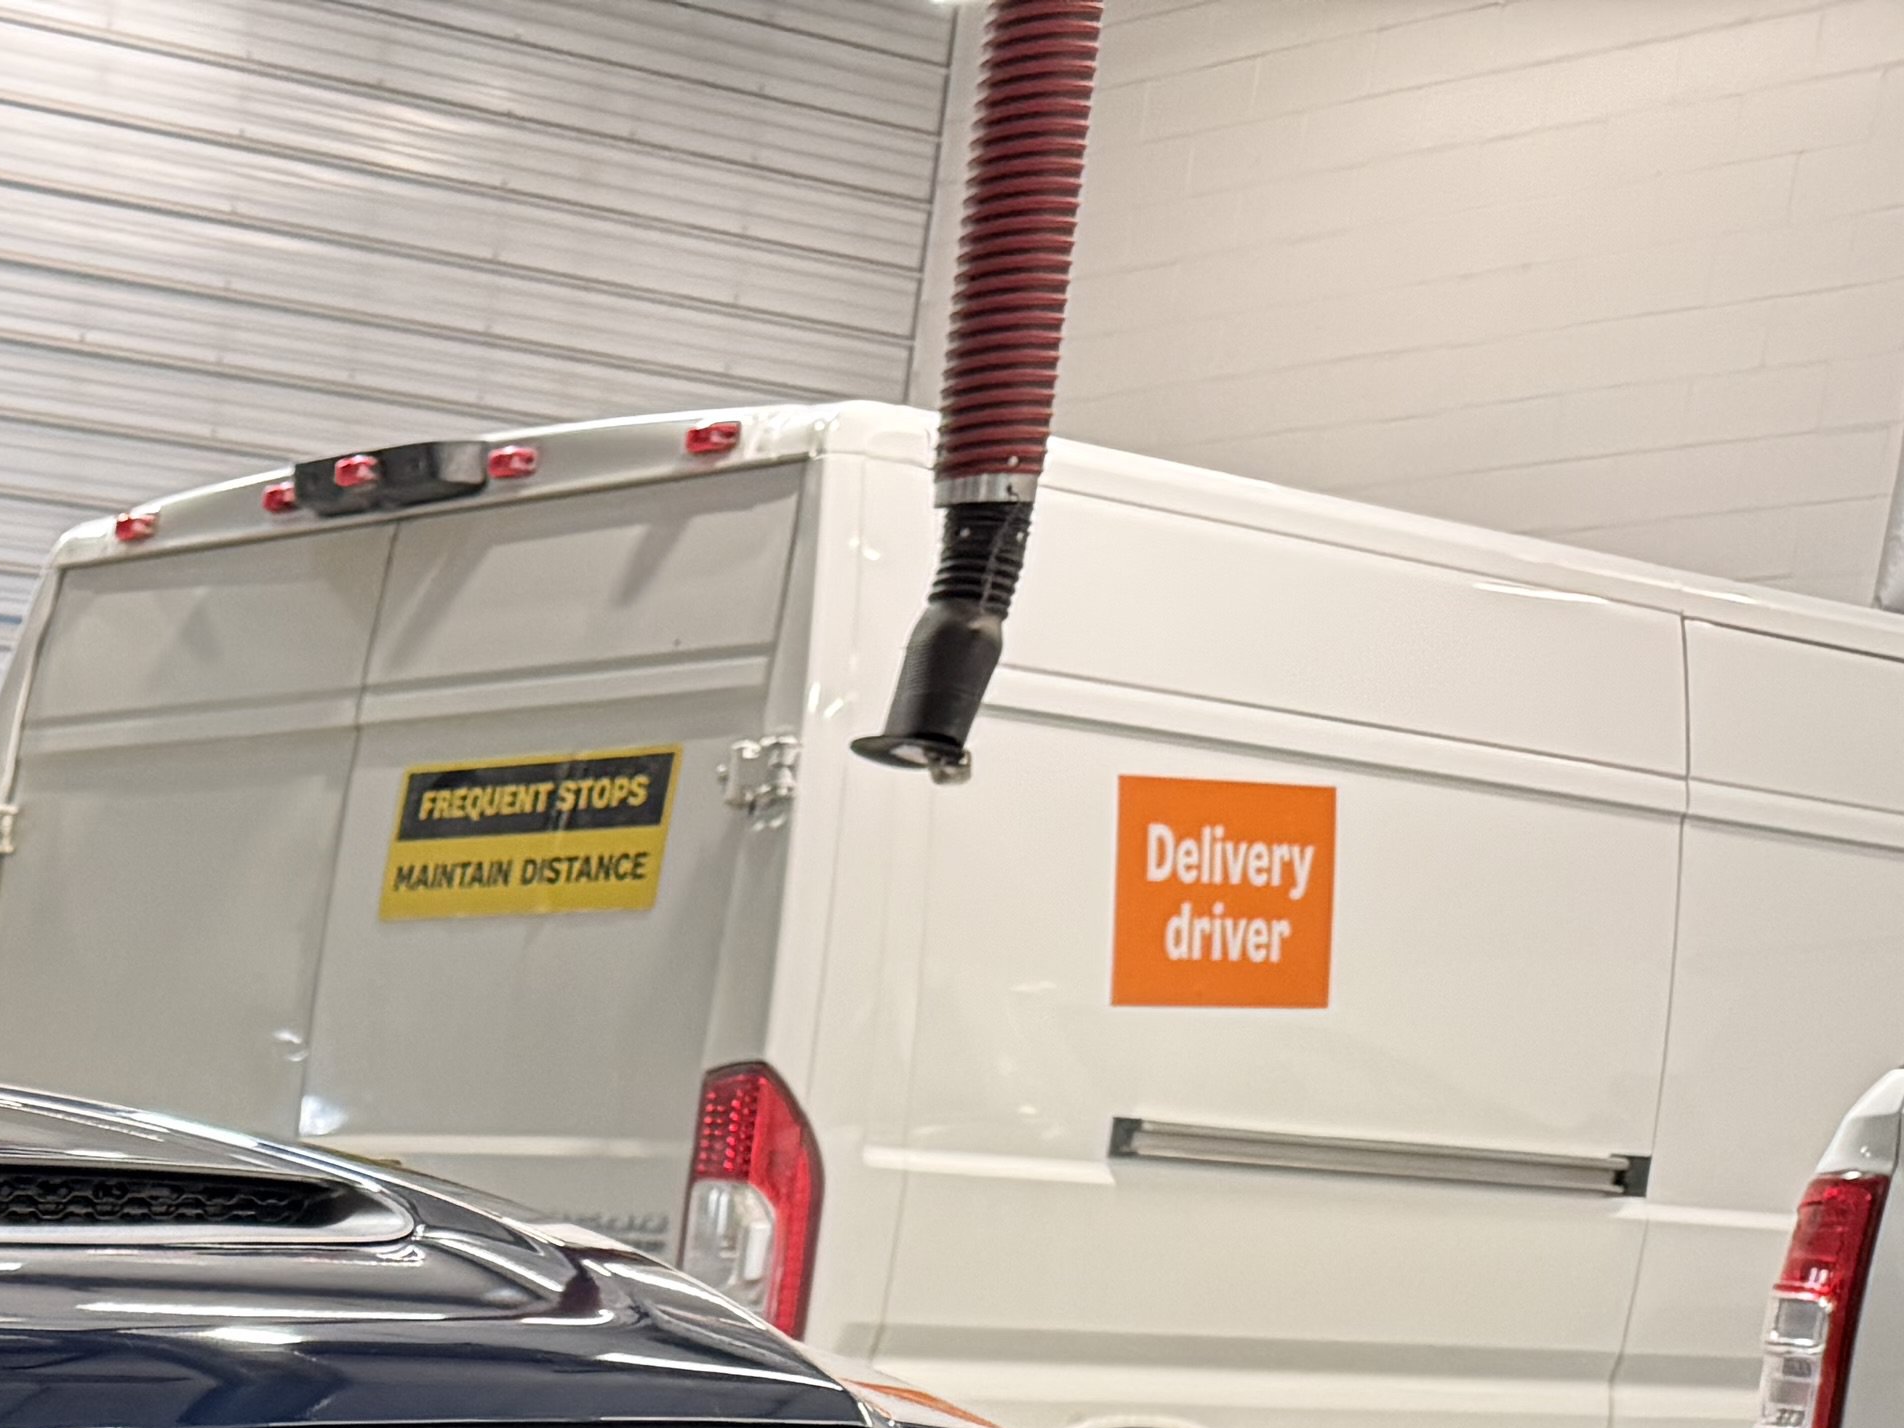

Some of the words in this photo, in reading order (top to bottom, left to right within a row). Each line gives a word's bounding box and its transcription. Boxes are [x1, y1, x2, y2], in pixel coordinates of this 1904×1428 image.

[418, 781, 555, 821] FREQUENT
[556, 772, 650, 812] STOPS
[393, 858, 512, 892] MAINTAIN
[520, 851, 650, 886] DISTANCE
[1145, 821, 1315, 901] Delivery
[1164, 900, 1292, 963] driver
